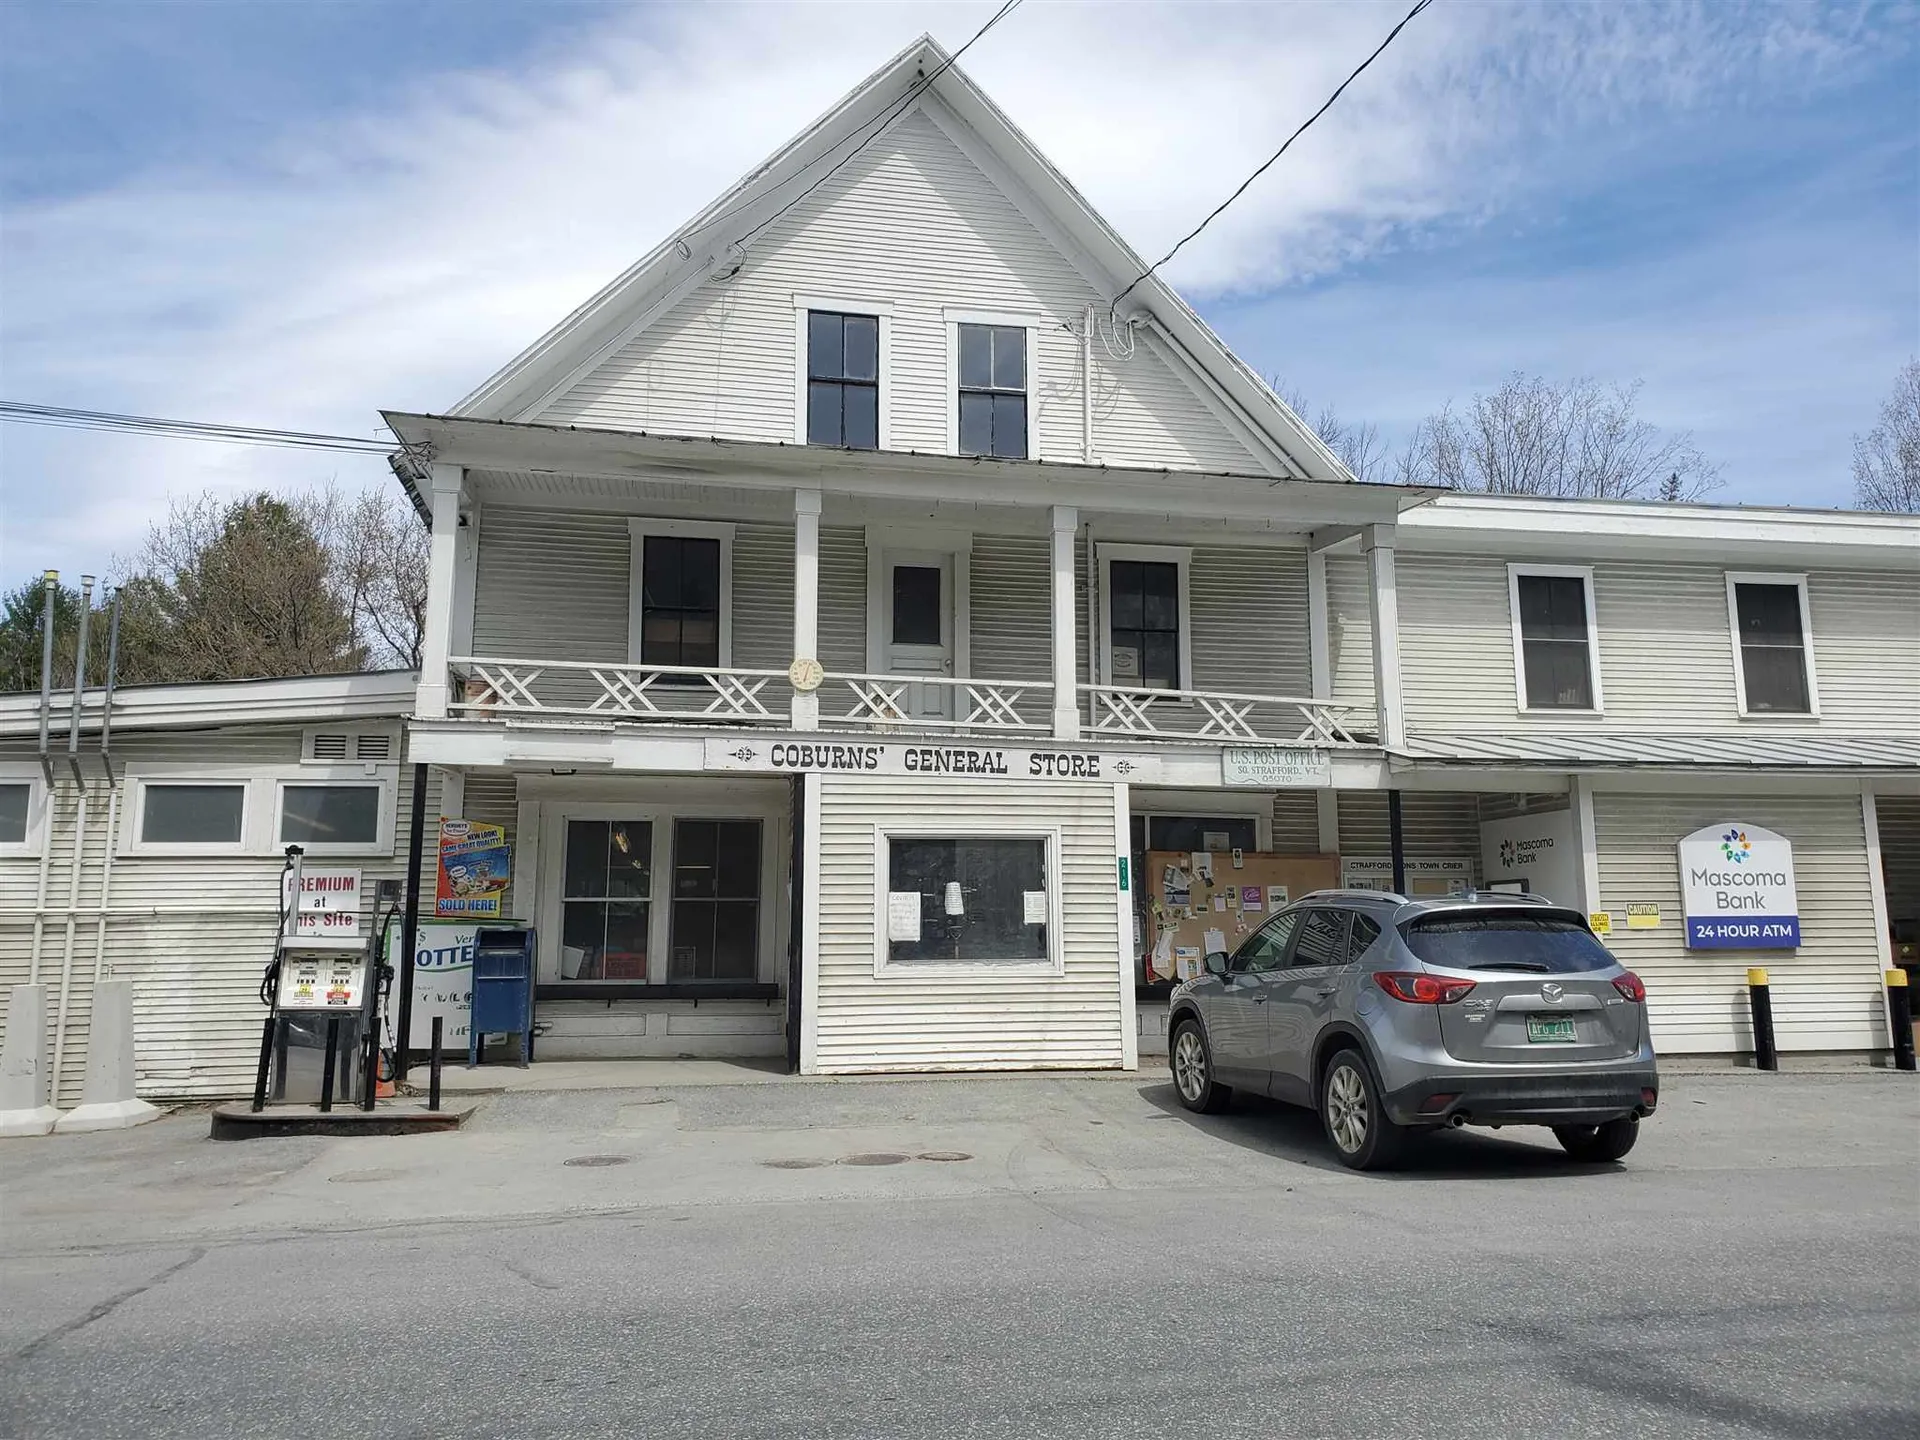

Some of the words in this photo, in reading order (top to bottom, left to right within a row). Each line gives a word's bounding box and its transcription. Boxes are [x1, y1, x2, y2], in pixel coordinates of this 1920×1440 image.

[771, 744, 885, 770] COBURNS'
[904, 748, 1008, 774] GENERAL
[1029, 753, 1100, 777] STORE
[1230, 750, 1251, 765] U.S.
[1253, 751, 1282, 765] POST
[1285, 751, 1324, 766] OFFICE
[1516, 838, 1554, 851] Mascoma
[1517, 852, 1537, 864] Bank
[1350, 862, 1392, 870] STRAFFORD
[1691, 867, 1787, 886] Mascoma
[314, 896, 326, 908] at
[439, 899, 465, 911] SOLD
[468, 899, 497, 911] HERE!
[1716, 891, 1766, 909] Bank
[1628, 904, 1658, 915] CAUTION
[323, 912, 353, 927] Site
[1696, 925, 1714, 938] 24
[1717, 925, 1759, 937] HOUR
[1763, 924, 1792, 937] ATM
[455, 934, 475, 944] Ver
[416, 945, 473, 967] OTTE
